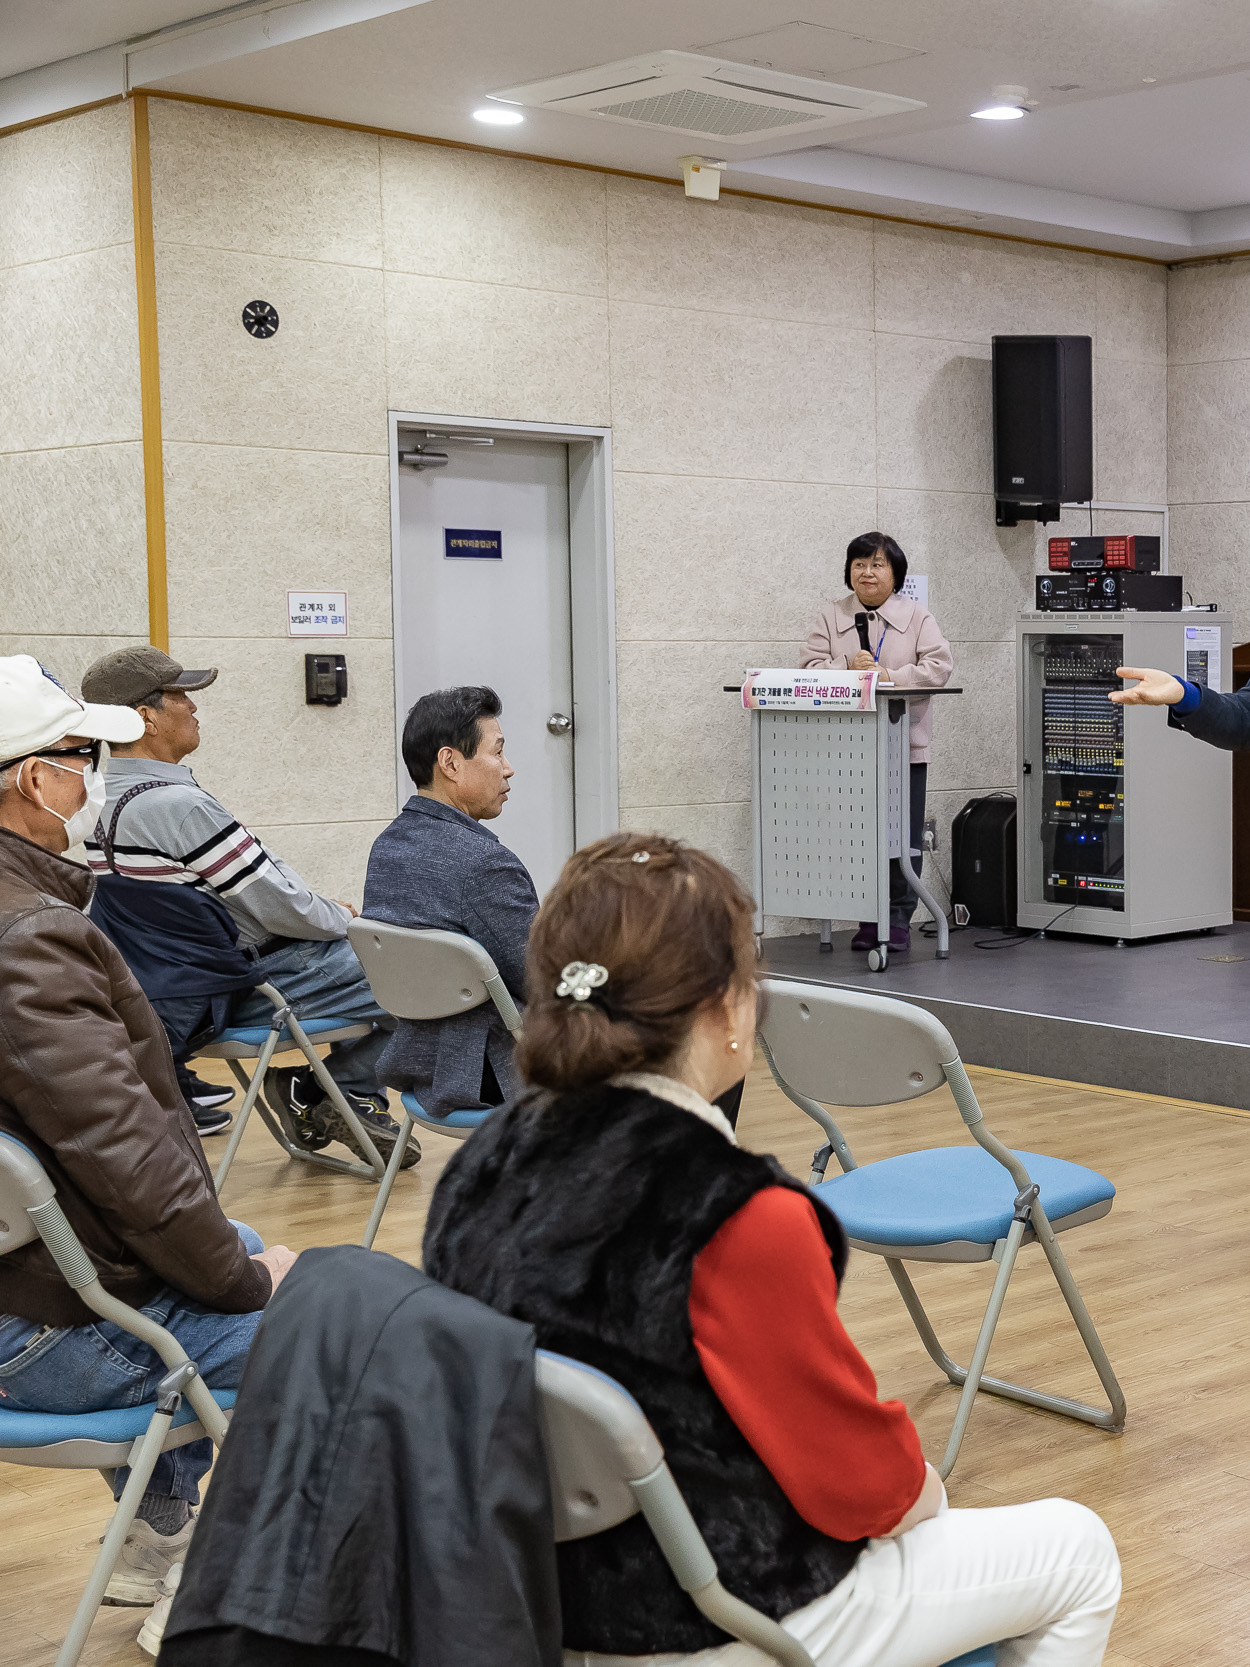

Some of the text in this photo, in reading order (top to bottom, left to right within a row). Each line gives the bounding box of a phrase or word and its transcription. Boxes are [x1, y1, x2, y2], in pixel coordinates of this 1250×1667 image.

[299, 603, 323, 612] 관계자
[794, 685, 814, 698] 어르신
[830, 686, 850, 698] ZERO
